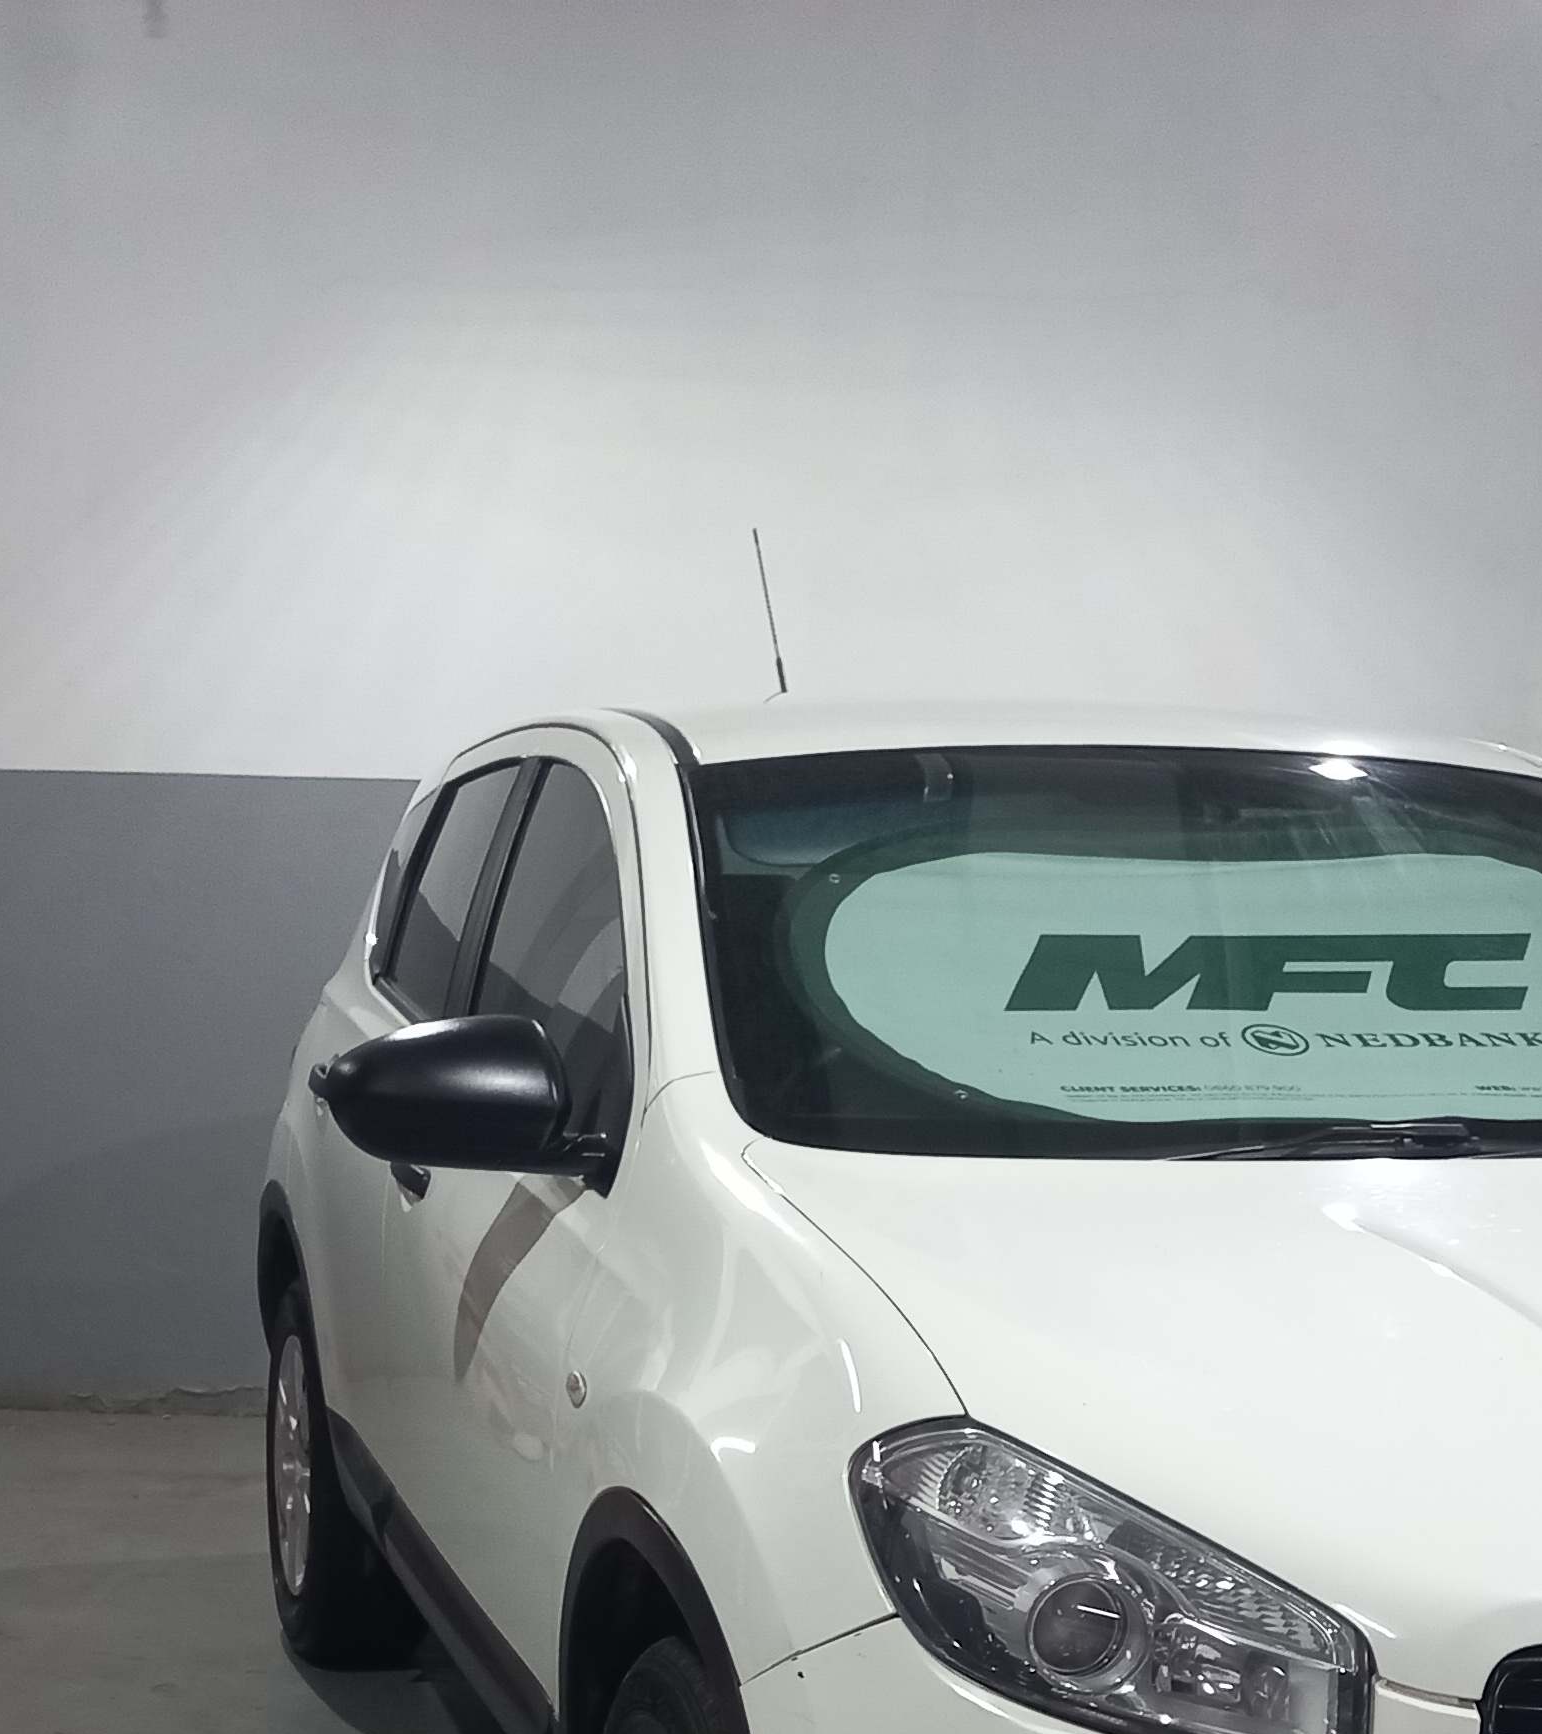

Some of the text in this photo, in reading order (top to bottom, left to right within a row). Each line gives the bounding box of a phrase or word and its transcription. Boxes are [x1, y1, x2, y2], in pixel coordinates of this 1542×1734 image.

[1004, 933, 1532, 1011] MFC
[1029, 1030, 1054, 1046] A
[1061, 1030, 1192, 1048] division
[1199, 1030, 1232, 1048] of
